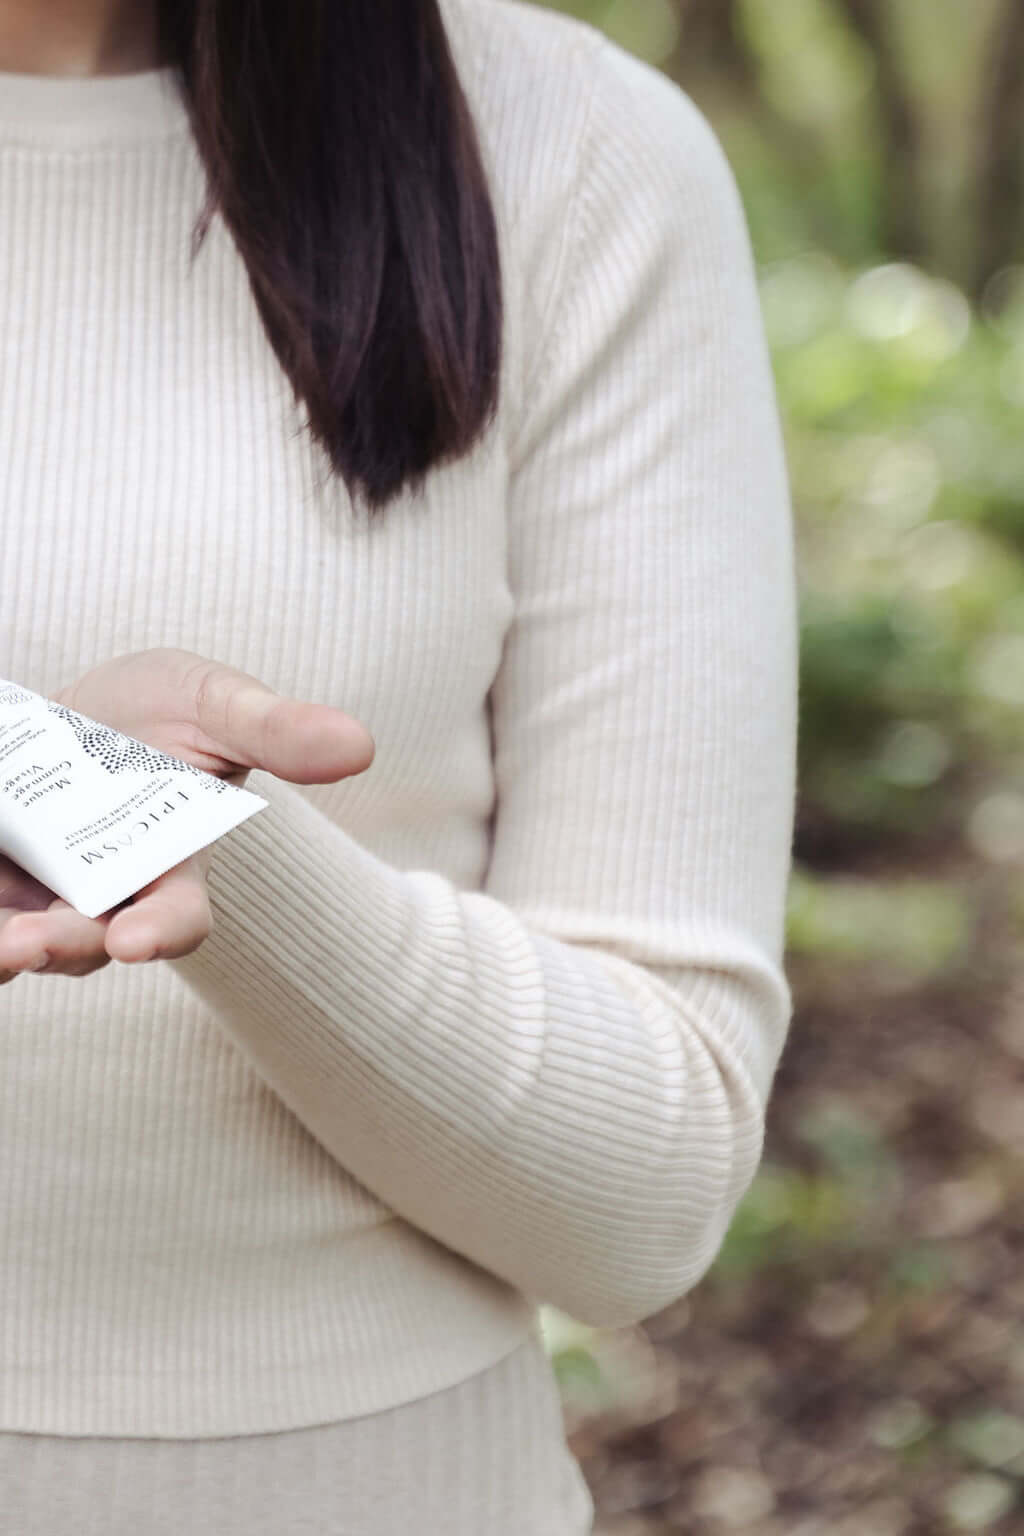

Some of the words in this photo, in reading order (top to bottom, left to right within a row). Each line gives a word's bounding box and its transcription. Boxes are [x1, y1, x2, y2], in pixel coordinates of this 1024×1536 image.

[3, 765, 45, 793] Visage
[12, 760, 73, 801] Gommage
[22, 778, 72, 808] Masque
